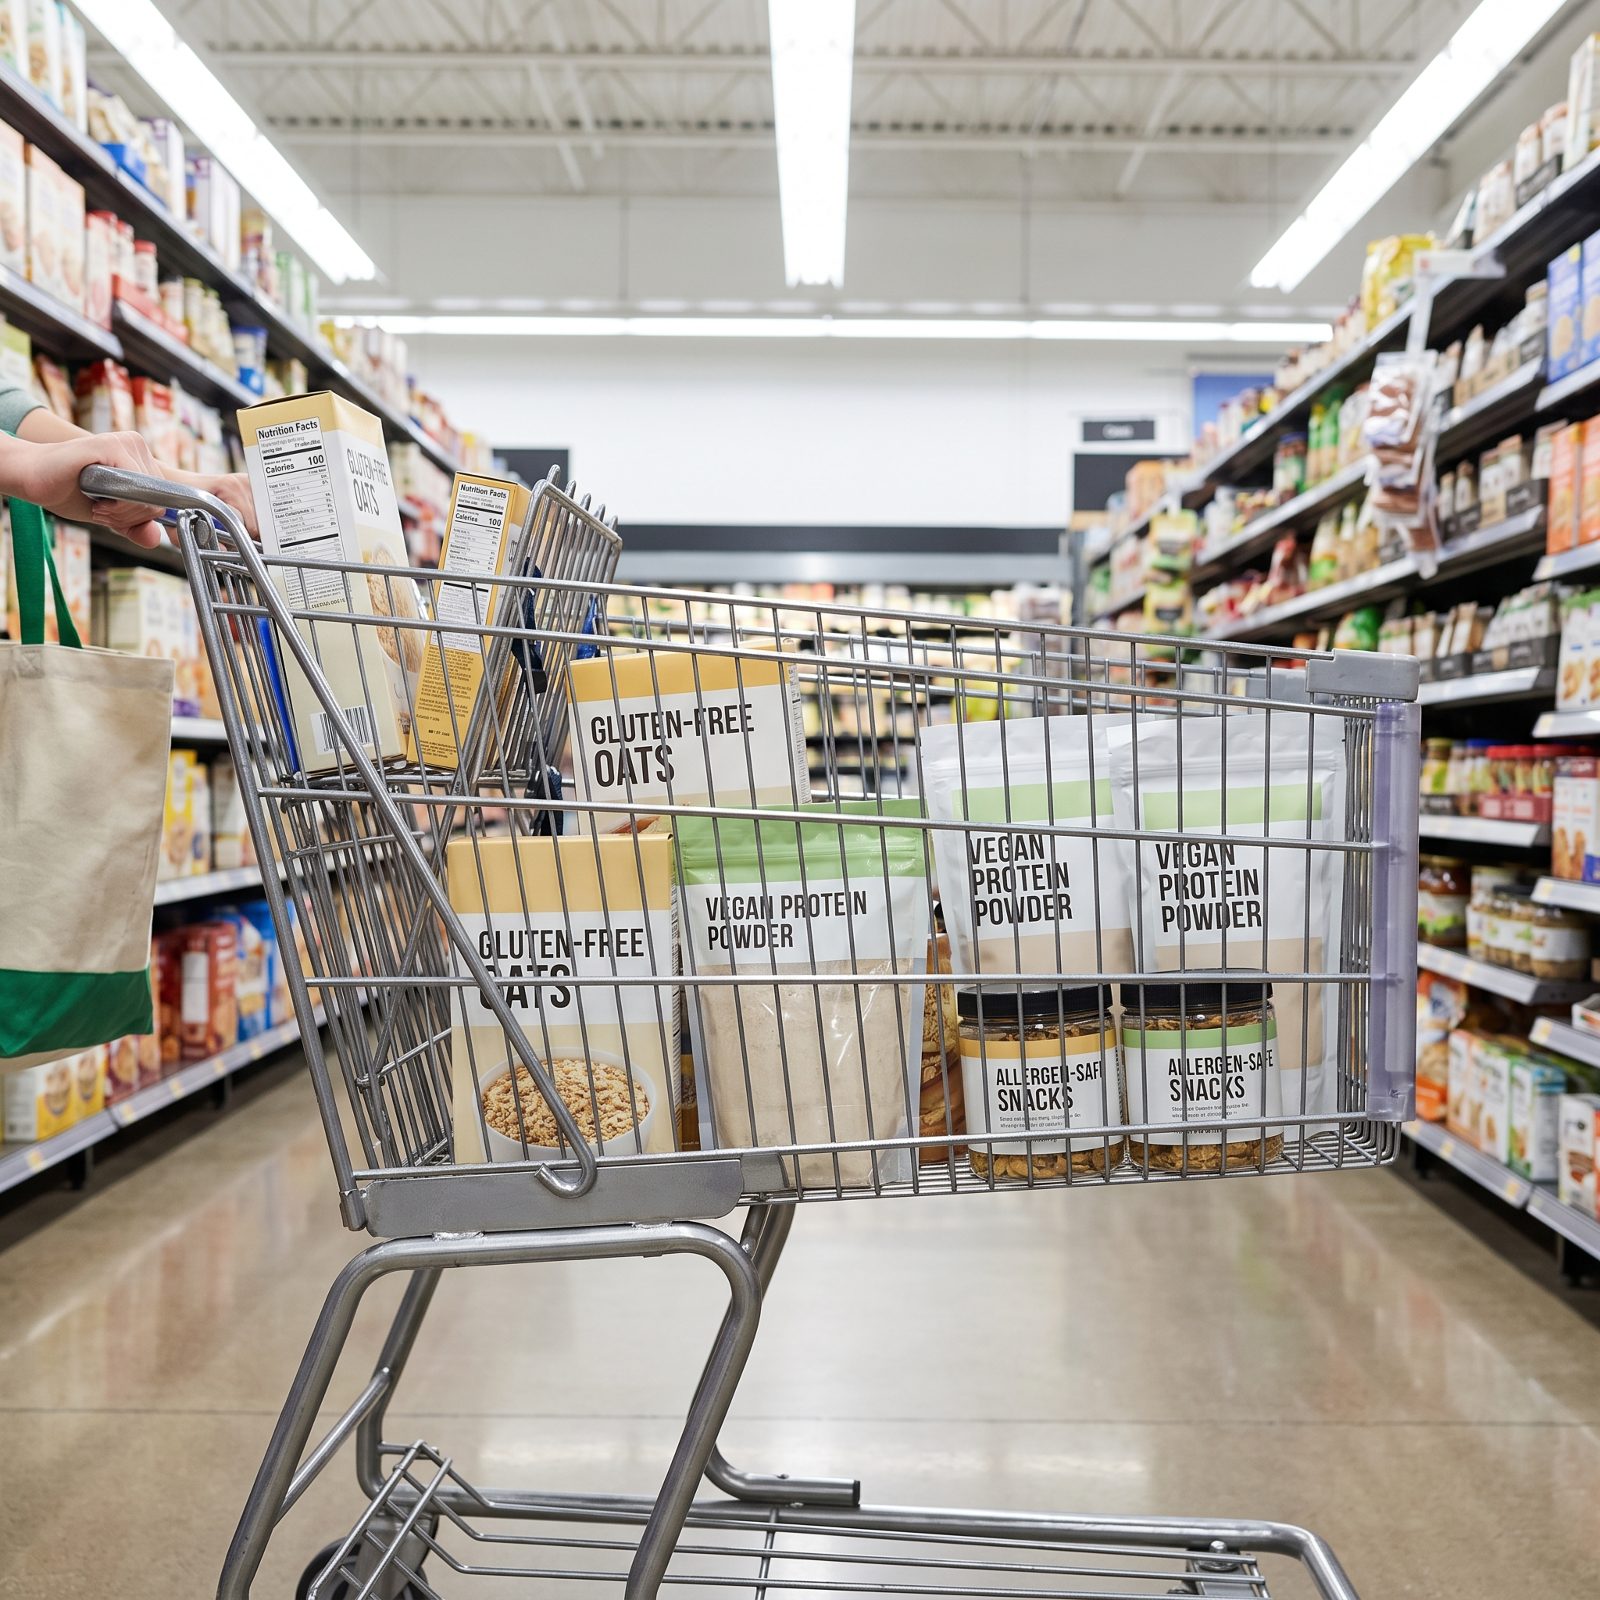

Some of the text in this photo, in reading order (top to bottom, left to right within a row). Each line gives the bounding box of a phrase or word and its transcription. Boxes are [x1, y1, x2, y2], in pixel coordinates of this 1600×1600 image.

[258, 421, 318, 440] Nutrition Facts
[265, 463, 295, 475] Calories
[308, 454, 324, 466] 100
[353, 478, 380, 516] OATS
[460, 484, 488, 495] Nutrition
[488, 517, 502, 527] 100
[590, 703, 755, 745] GLUTEN-FREE
[594, 744, 675, 788] OATS
[969, 834, 1045, 865] VEGAN
[1155, 841, 1236, 870] VEGAN
[972, 862, 1070, 896] PROTEIN
[1158, 868, 1260, 901] PROTEIN
[705, 895, 774, 921] VEGAN
[974, 893, 1073, 927] POWDER
[1161, 900, 1262, 933] POWDER
[478, 928, 645, 960] GLUTEN-FREE
[707, 923, 794, 950] POWDER
[997, 1086, 1074, 1112] SNACKS
[1169, 1075, 1245, 1102] SNACKS
